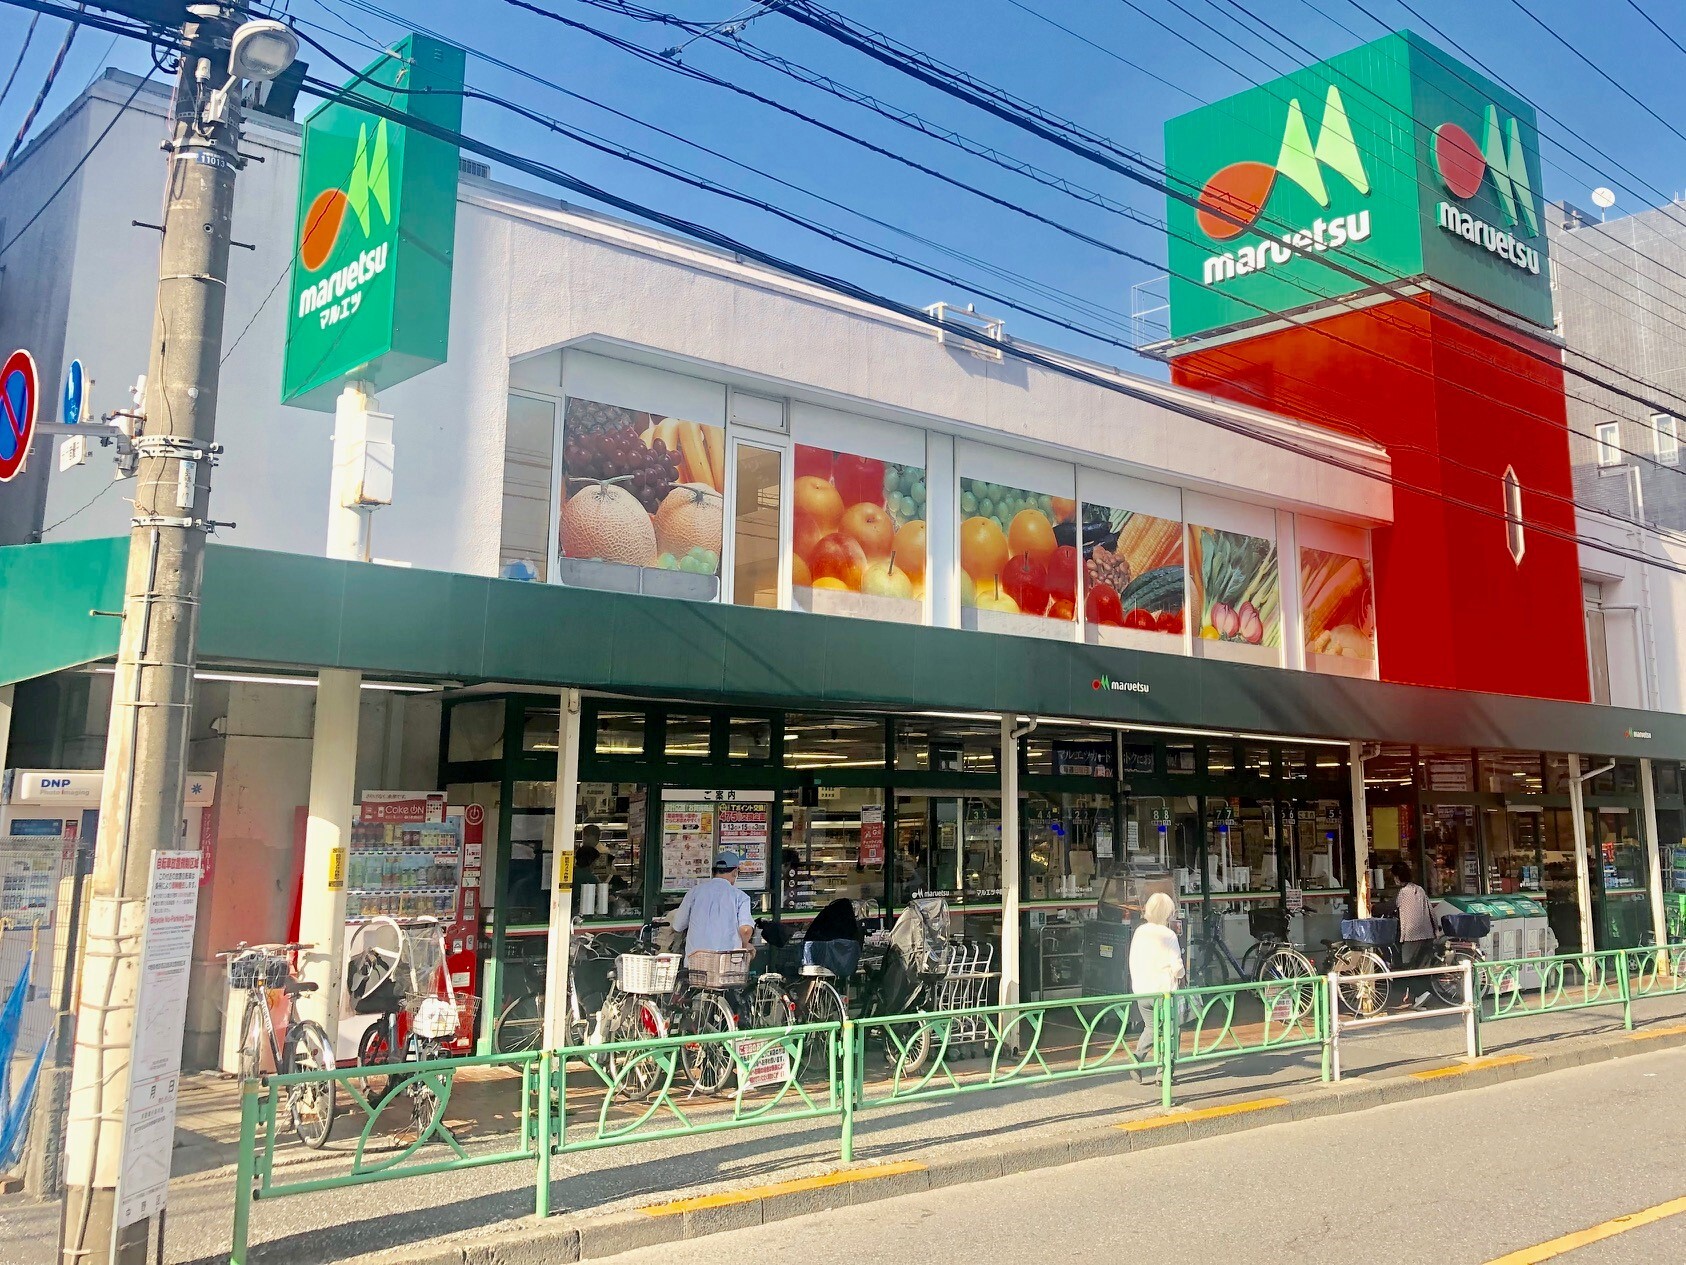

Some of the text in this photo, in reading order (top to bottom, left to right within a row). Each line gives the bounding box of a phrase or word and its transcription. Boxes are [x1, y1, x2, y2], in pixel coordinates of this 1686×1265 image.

[1436, 201, 1541, 275] maruetsu
[1203, 210, 1371, 286] maruetsu
[298, 241, 388, 318] maruetsu
[319, 290, 362, 330] マルエツ
[1111, 681, 1150, 693] maruetsu
[41, 779, 71, 788] DNP
[704, 790, 736, 801] ご案内
[385, 805, 425, 815] Coke ON
[150, 916, 164, 924] Bicycle
[185, 913, 194, 921] Zone
